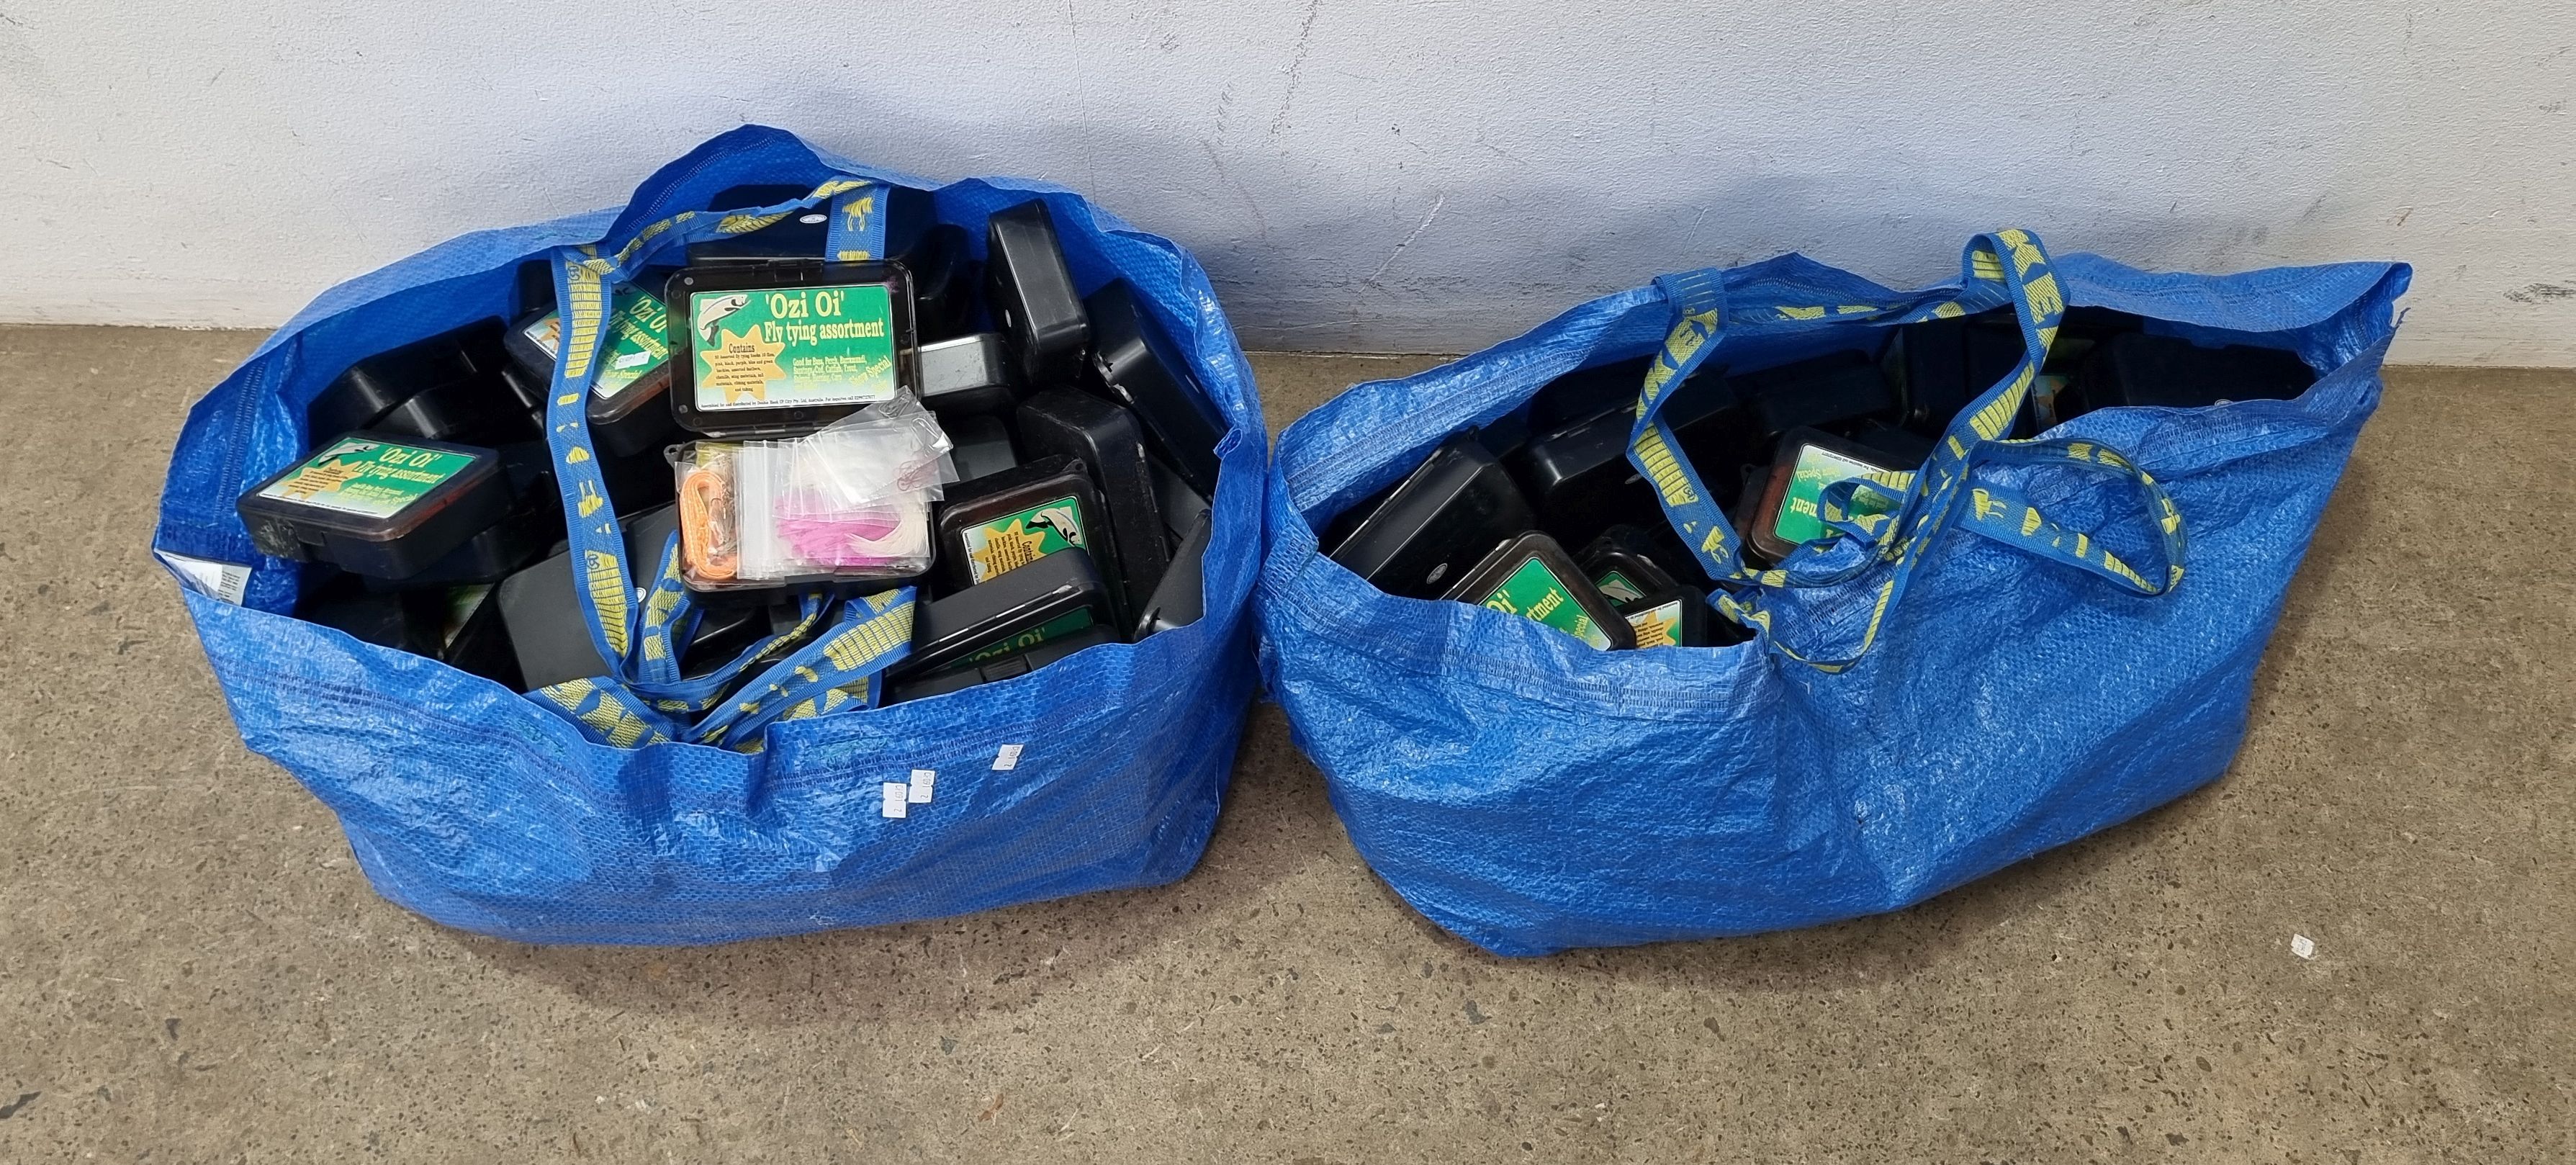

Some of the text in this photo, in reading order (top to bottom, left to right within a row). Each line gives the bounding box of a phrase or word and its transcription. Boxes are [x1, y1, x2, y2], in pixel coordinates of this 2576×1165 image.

[765, 290, 845, 318] 'Ozi Oi'
[765, 318, 885, 346] Fly tying assortment
[729, 343, 755, 354] Contains
[866, 356, 892, 377] Special
[1526, 587, 1564, 622] rtment
